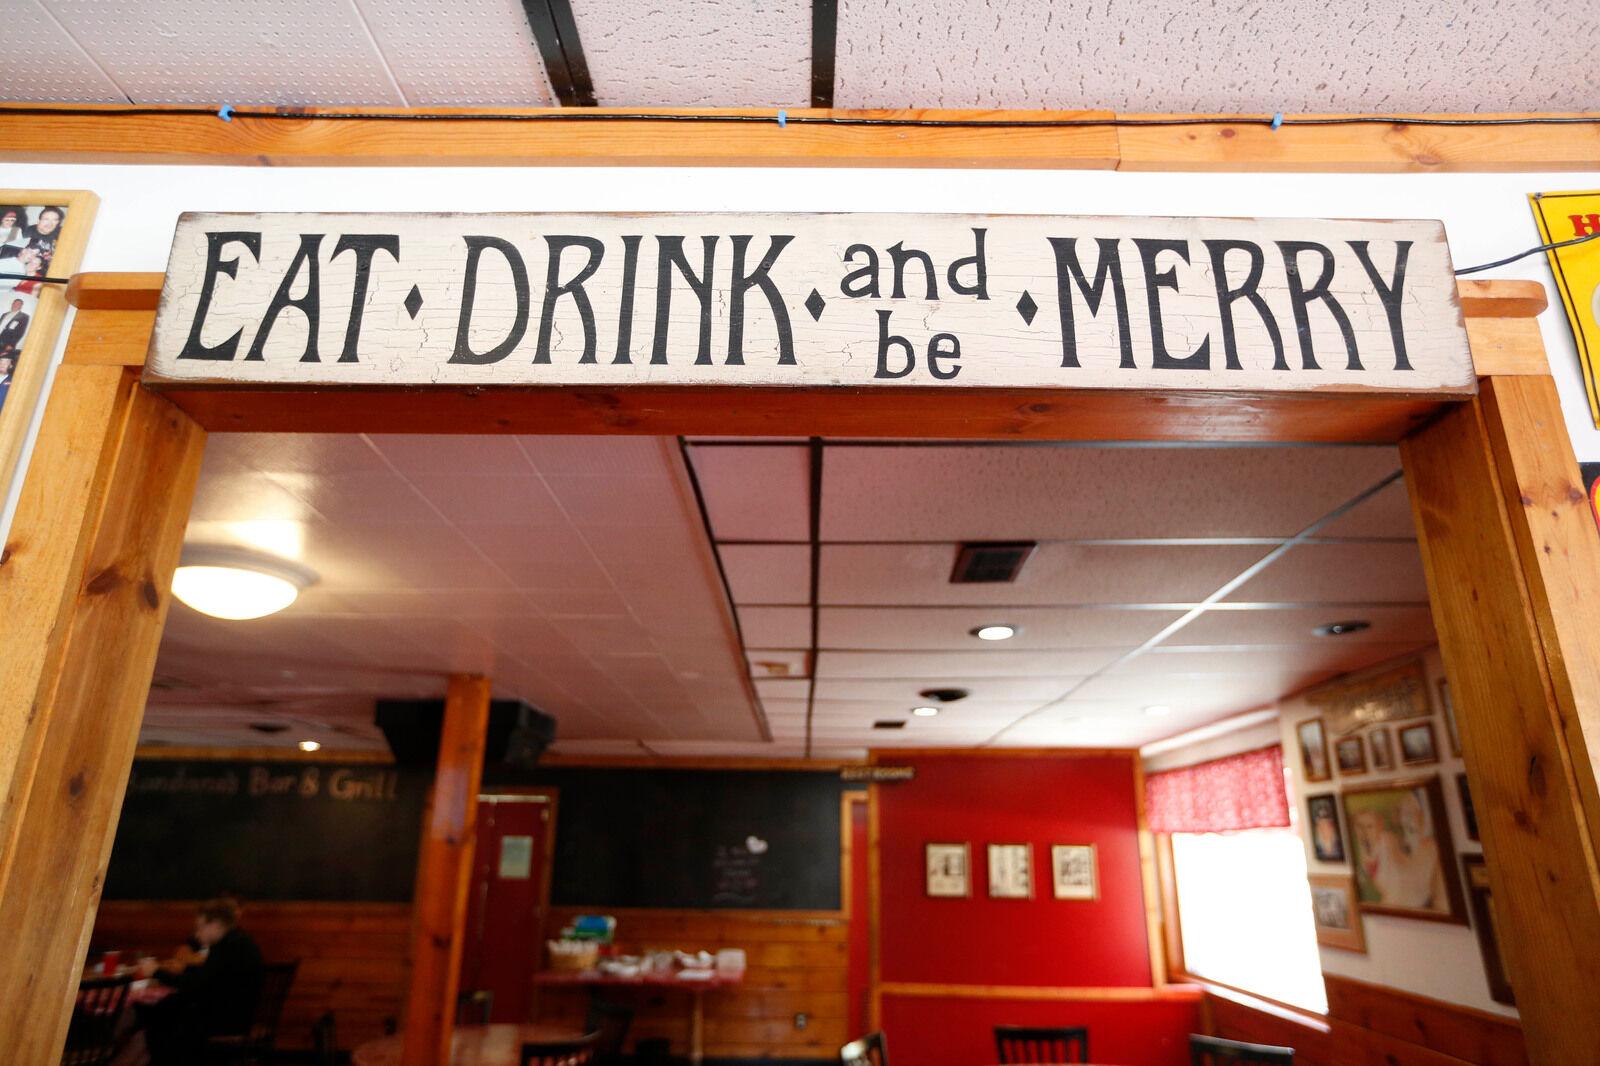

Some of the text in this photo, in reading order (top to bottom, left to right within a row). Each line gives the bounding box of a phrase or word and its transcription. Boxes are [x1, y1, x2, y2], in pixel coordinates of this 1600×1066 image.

[177, 228, 1413, 370] EAT DRINK and MERRY
[874, 310, 961, 379] be
